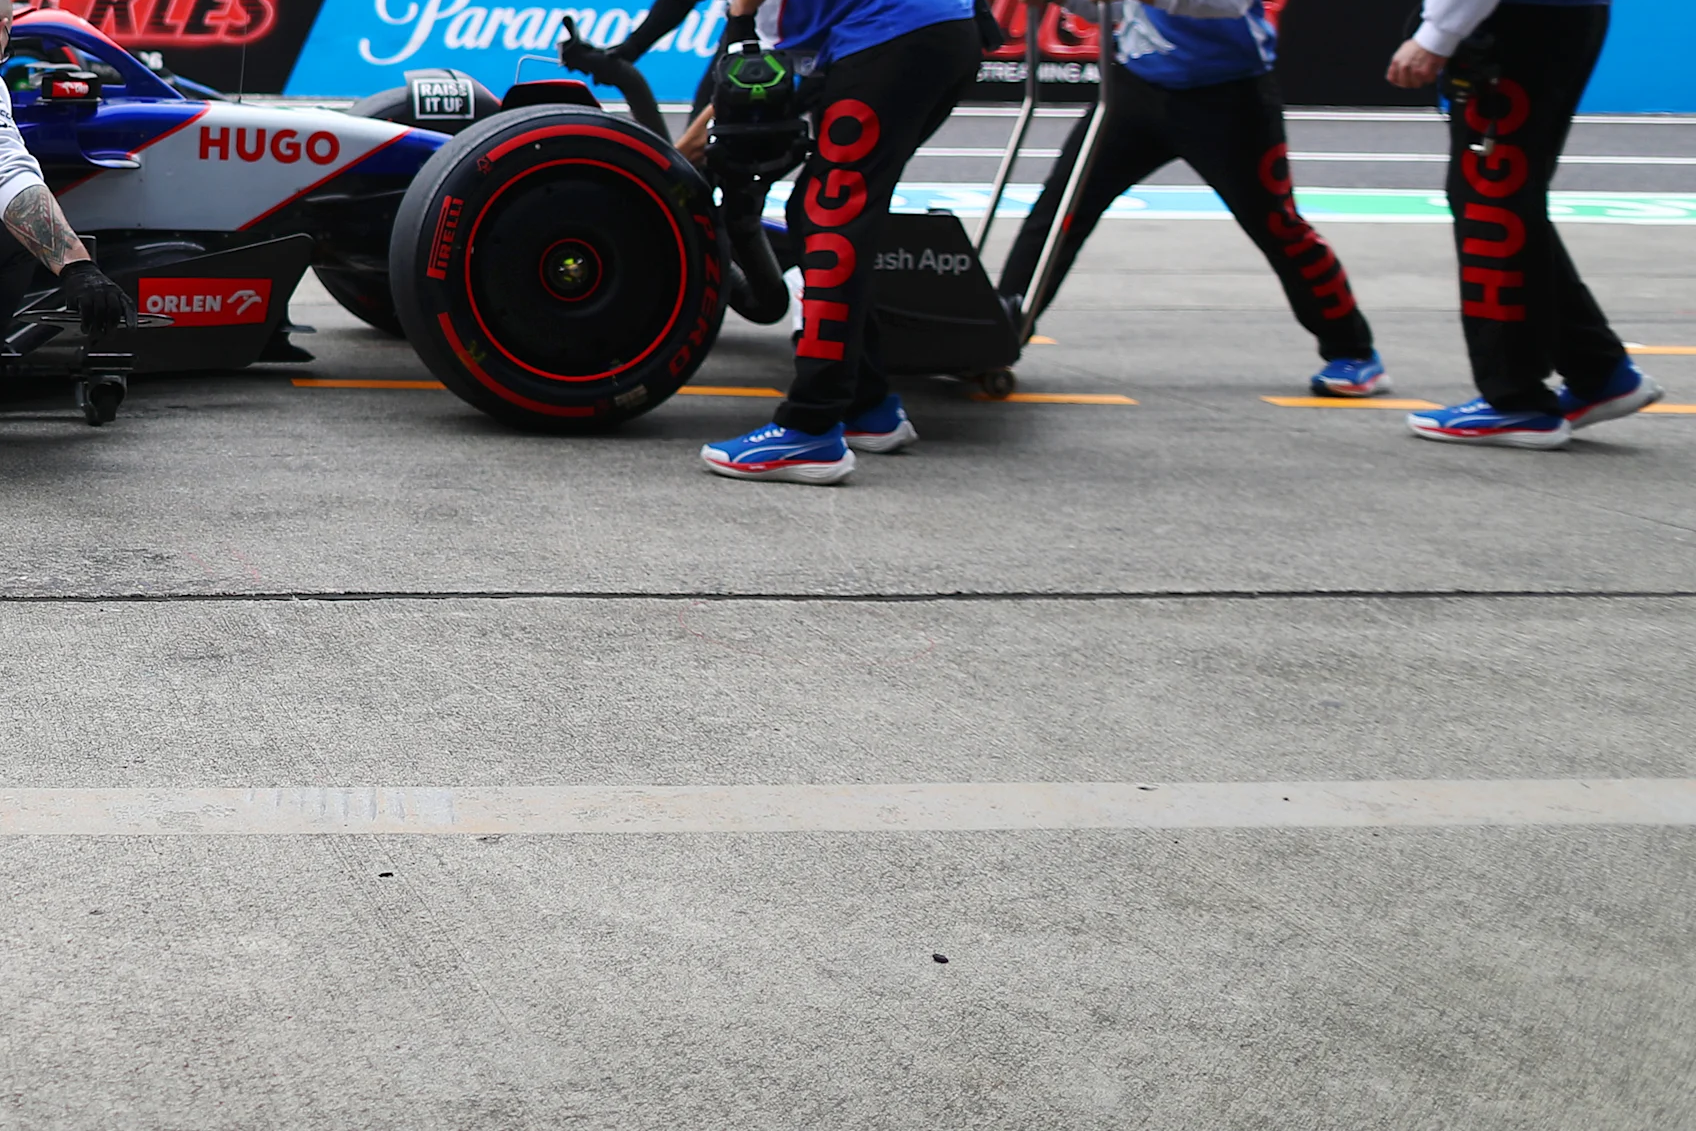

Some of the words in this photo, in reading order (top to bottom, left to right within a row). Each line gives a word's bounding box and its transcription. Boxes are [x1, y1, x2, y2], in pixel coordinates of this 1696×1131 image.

[420, 83, 468, 97] RAISE
[425, 97, 441, 112] IT
[444, 97, 464, 112] UP
[199, 126, 340, 165] HUGO
[1460, 77, 1531, 322] HUGO
[426, 195, 465, 281] PIRELLI
[796, 98, 881, 361] HUGO
[918, 248, 972, 275] App
[146, 295, 222, 313] ORLEN
[669, 253, 721, 377] ZERO
